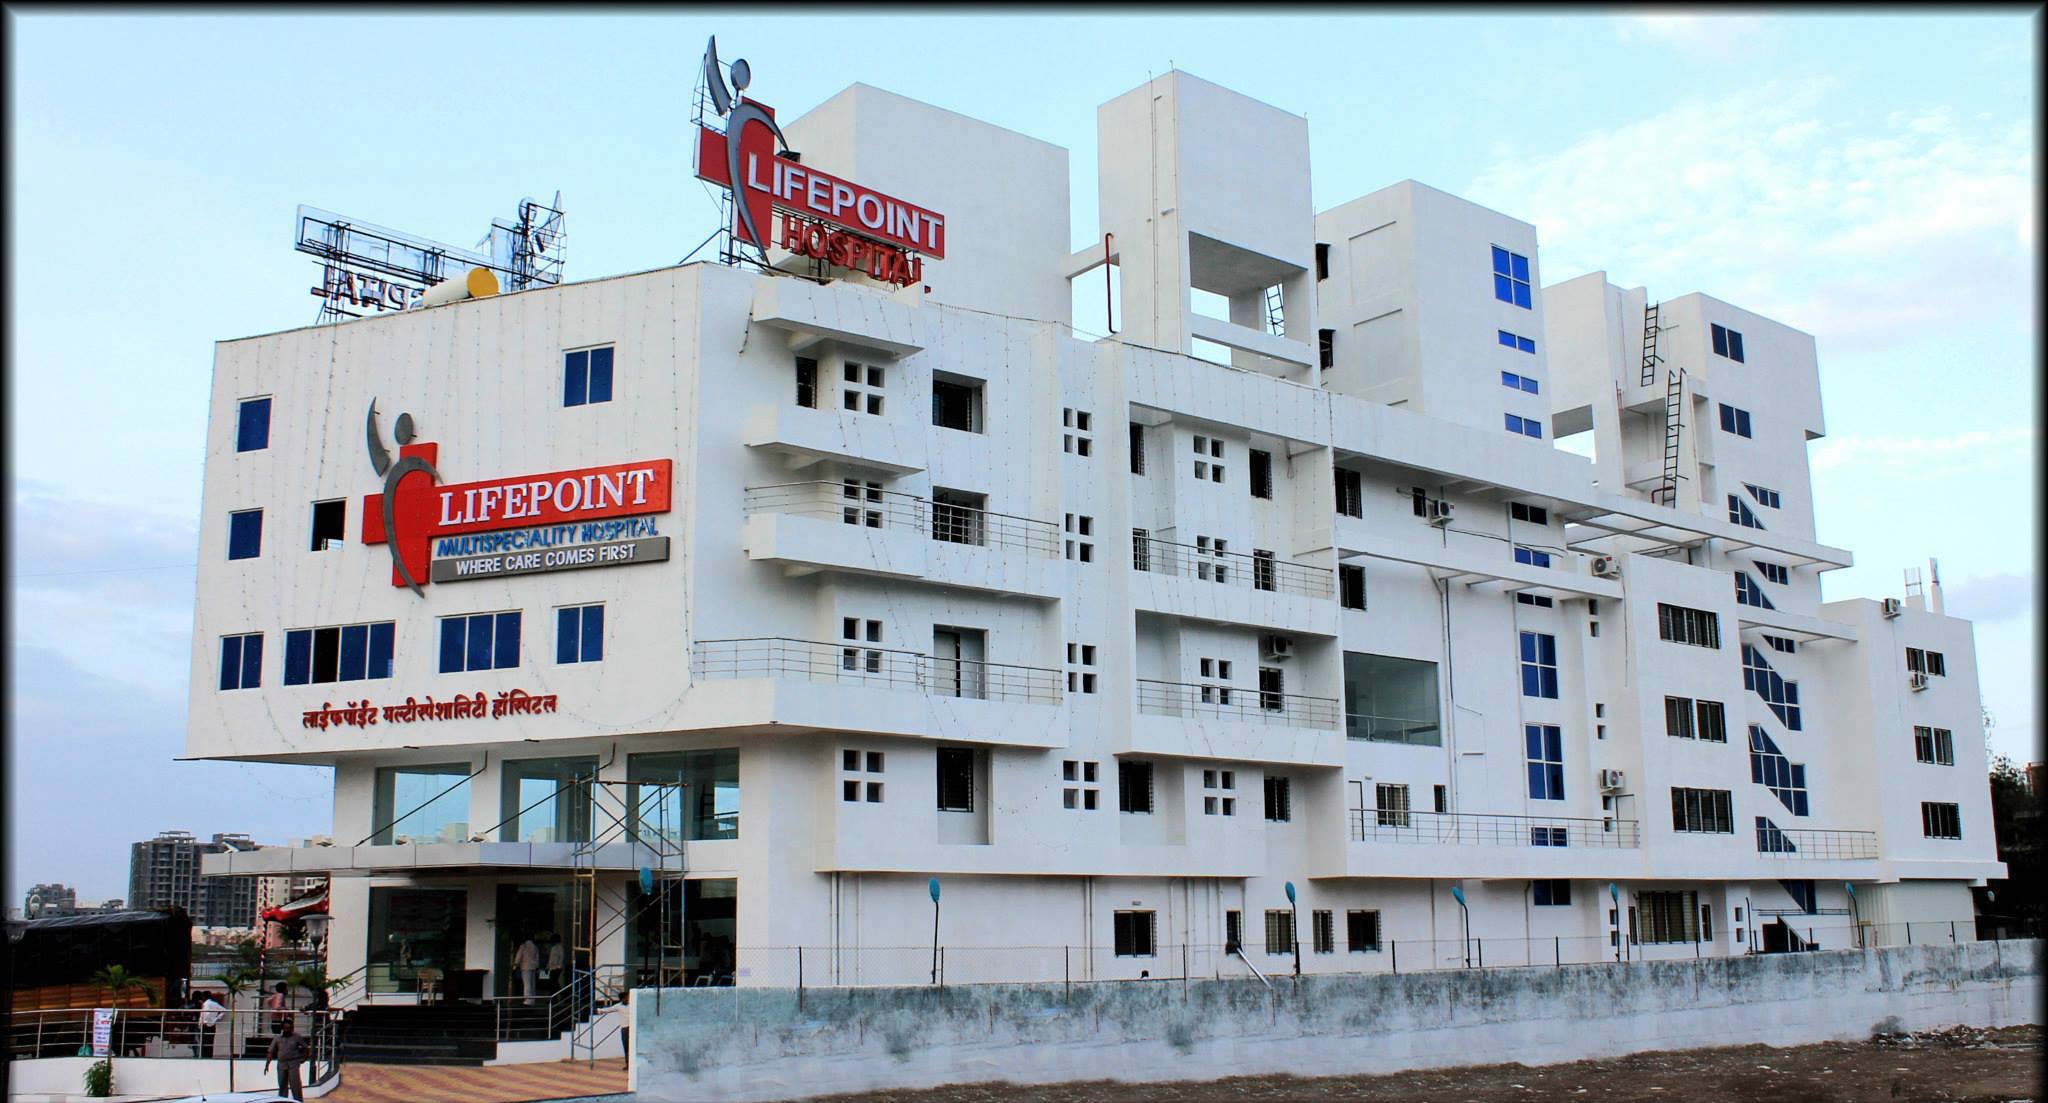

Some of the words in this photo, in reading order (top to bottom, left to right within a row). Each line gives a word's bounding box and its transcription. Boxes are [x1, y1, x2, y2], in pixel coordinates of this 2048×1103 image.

[748, 152, 943, 249] LIFEPOINT
[438, 469, 654, 526] LIFEPOINT
[436, 525, 577, 556] MULTISPECIALITY
[580, 517, 658, 542] HOSPITAL
[456, 559, 501, 576] WHERE
[505, 553, 541, 570] CARE
[545, 548, 595, 567] COMES
[599, 543, 636, 562] FIRST
[491, 688, 558, 719] हॉस्पिटल
